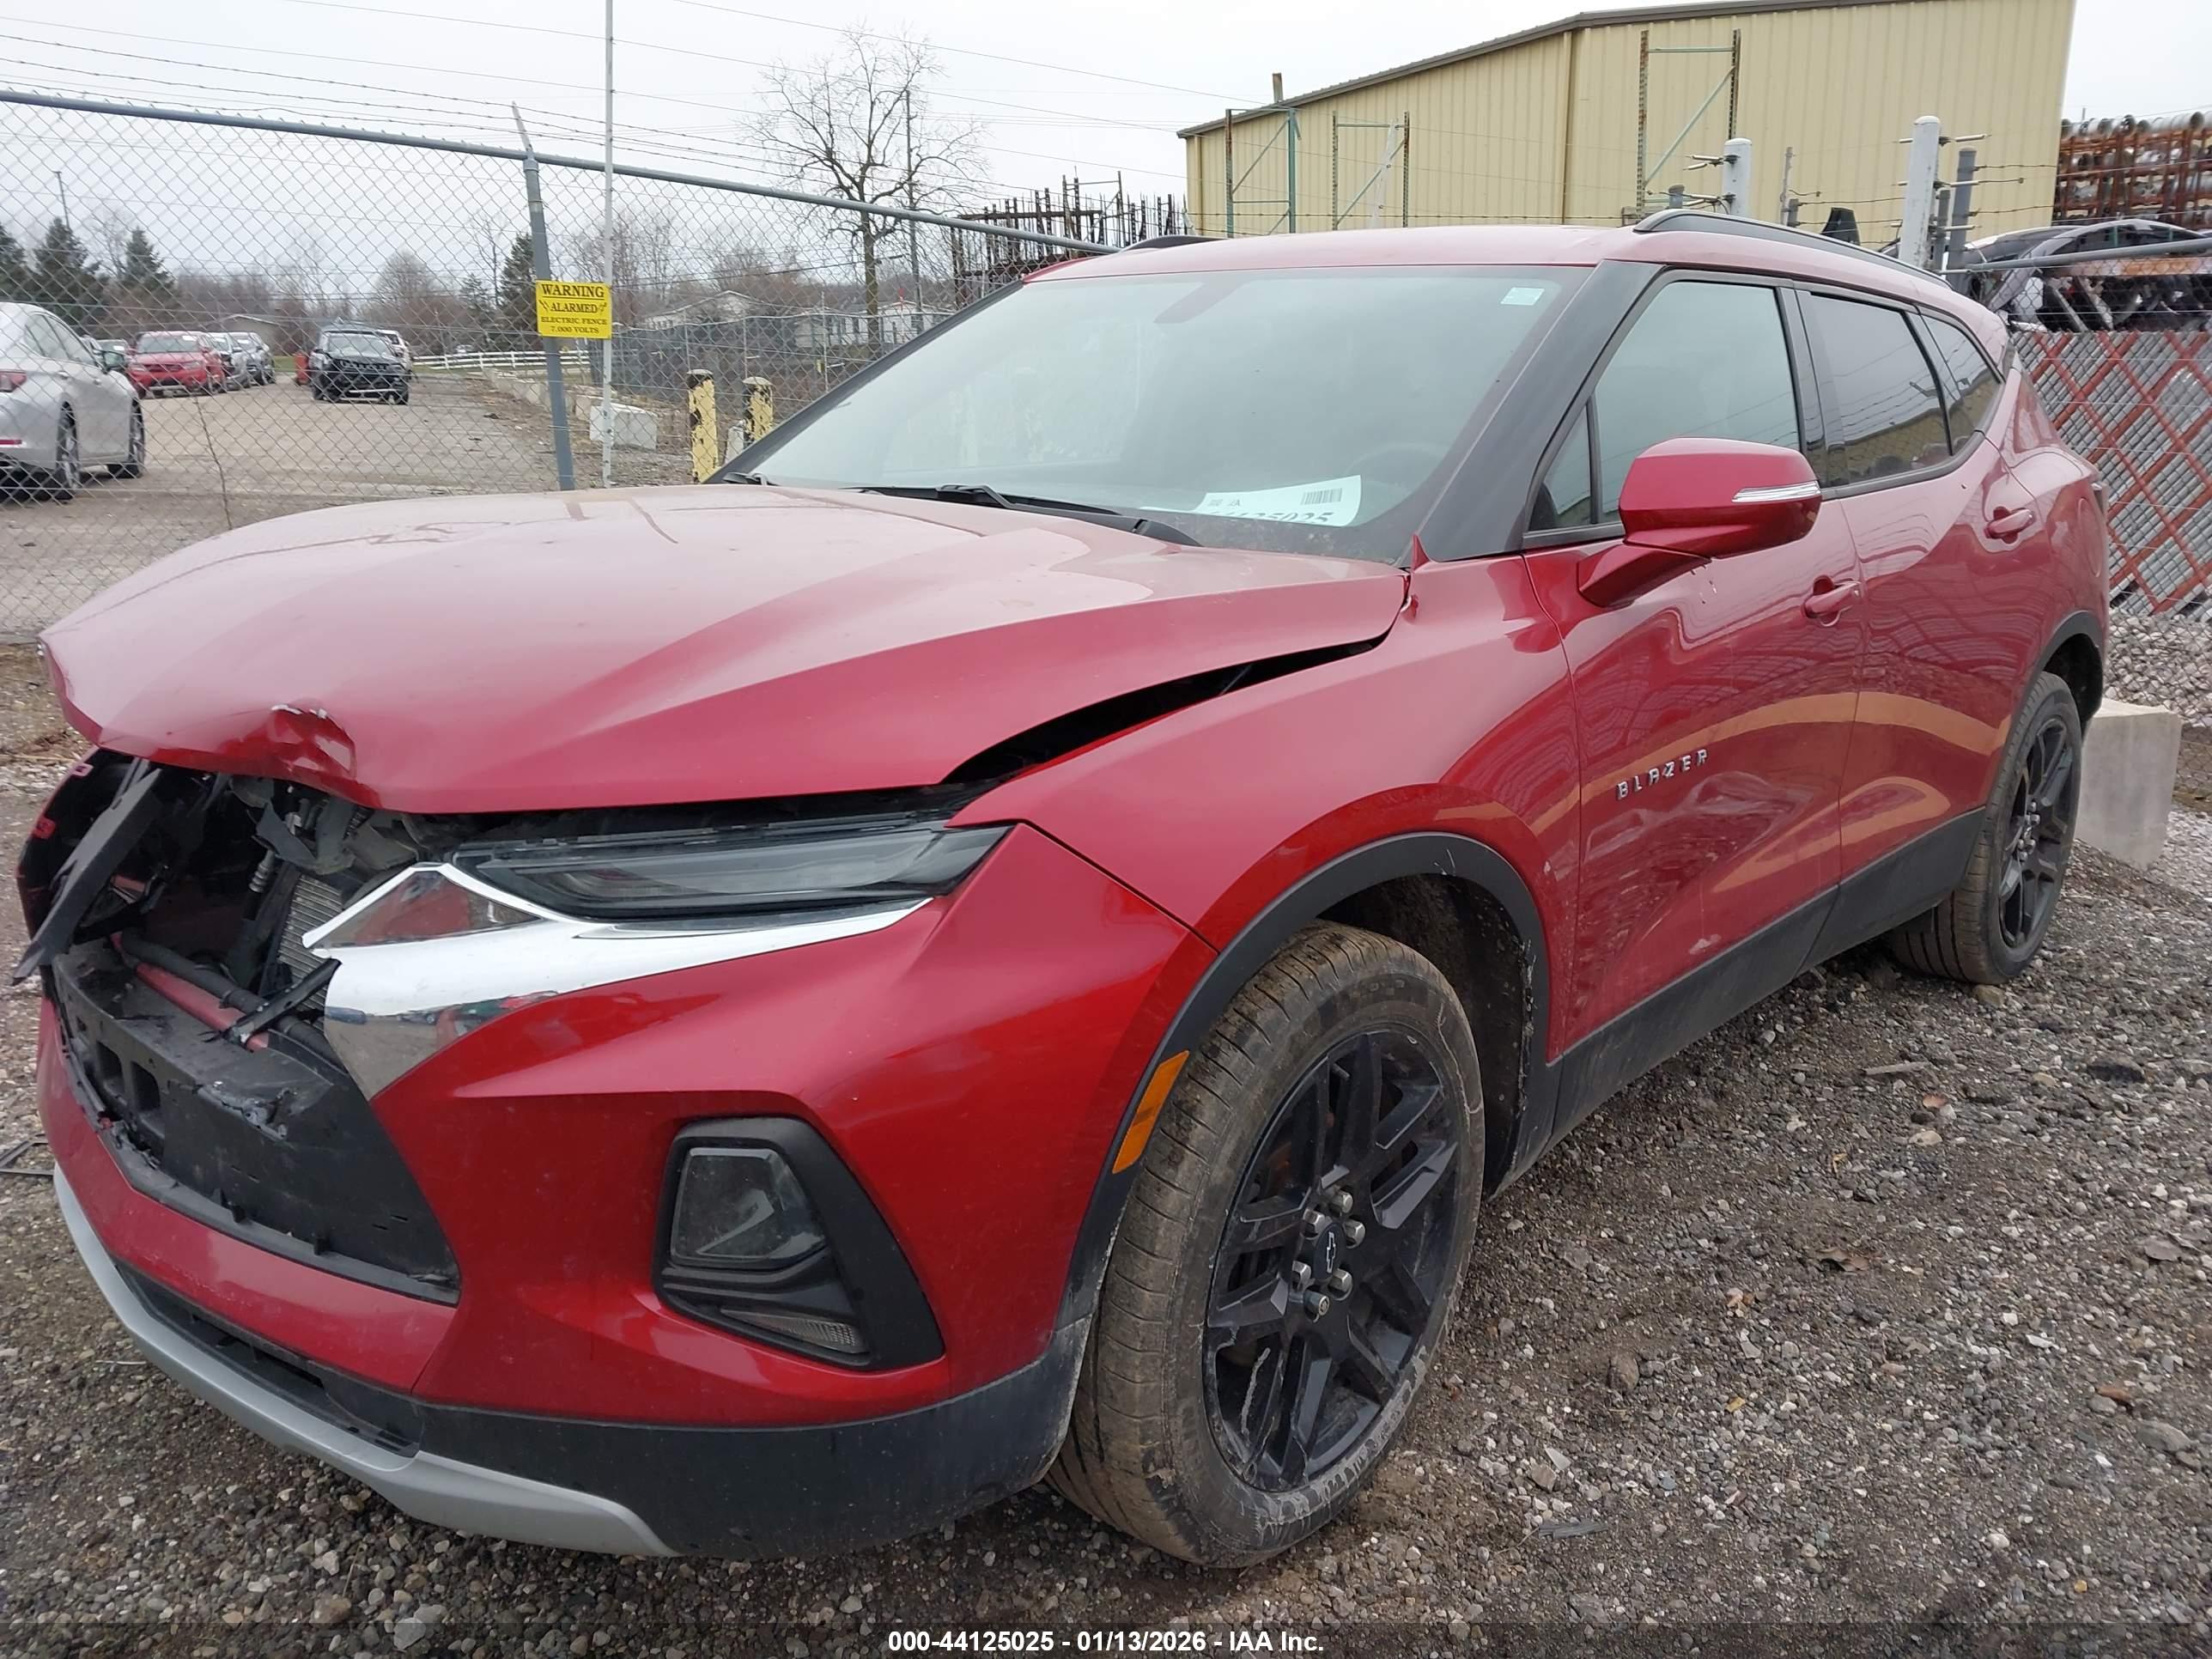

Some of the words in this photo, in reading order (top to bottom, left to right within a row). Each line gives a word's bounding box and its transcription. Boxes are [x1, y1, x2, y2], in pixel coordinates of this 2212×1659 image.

[542, 284, 605, 297] WARNING
[550, 301, 599, 313] ALARMED
[1617, 749, 1707, 799] BLAZER
